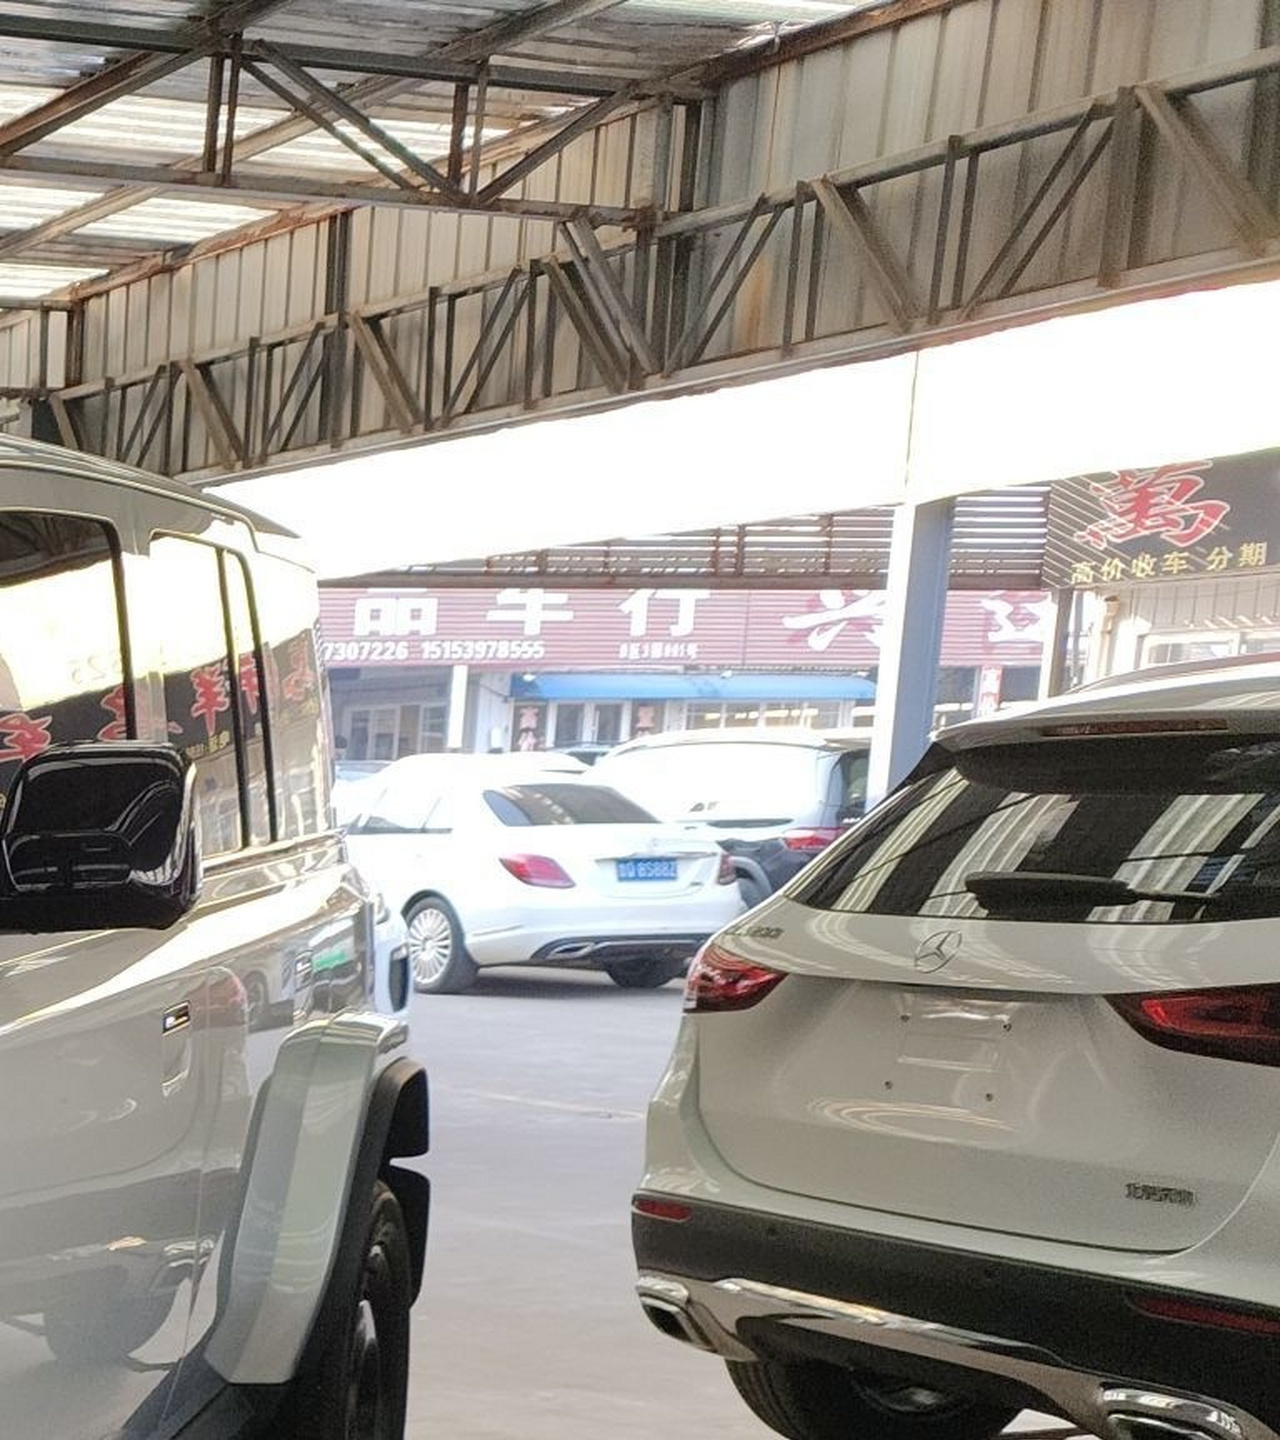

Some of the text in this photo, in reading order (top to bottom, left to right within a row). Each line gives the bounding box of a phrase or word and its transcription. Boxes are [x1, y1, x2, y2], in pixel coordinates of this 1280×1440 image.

[1071, 541, 1268, 584] 高价收车 分期
[417, 640, 546, 660] 15153978555
